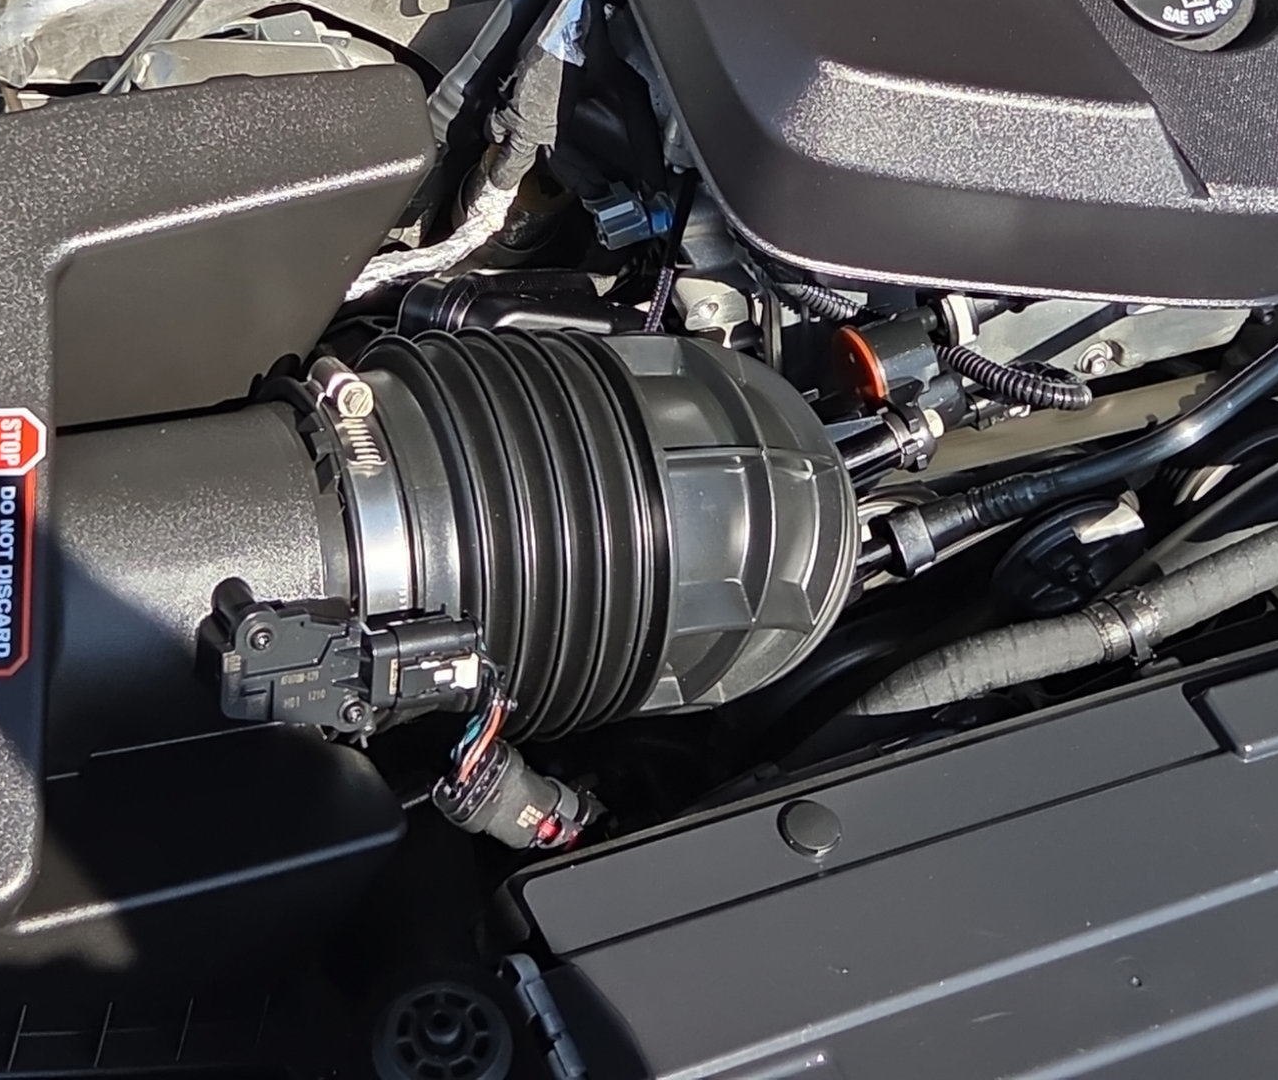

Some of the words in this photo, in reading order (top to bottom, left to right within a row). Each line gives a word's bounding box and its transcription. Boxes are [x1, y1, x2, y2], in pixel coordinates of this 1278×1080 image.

[1162, 5, 1190, 25] SAE
[0, 418, 22, 465] STOP
[0, 486, 16, 514] DO
